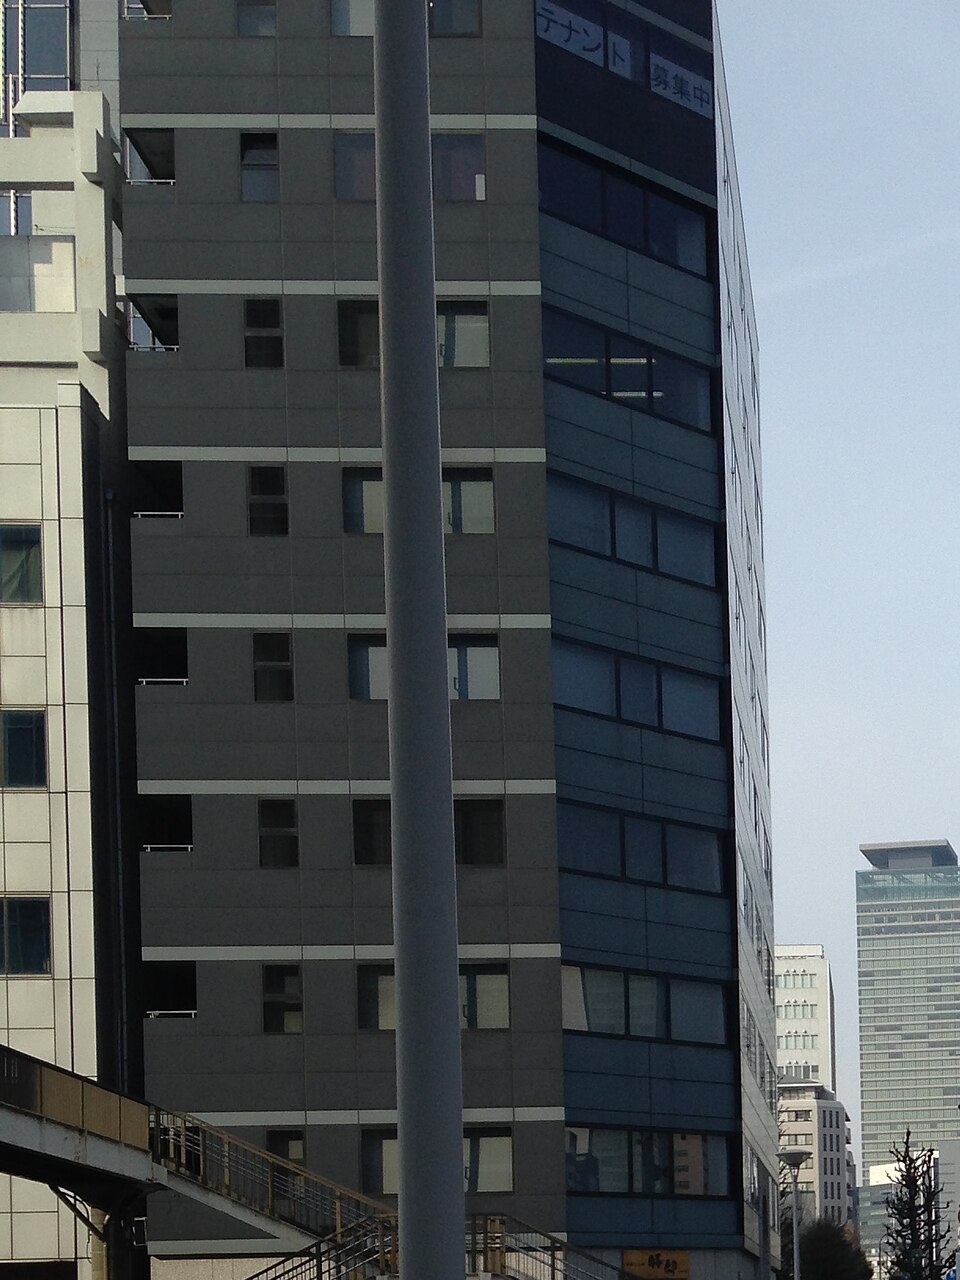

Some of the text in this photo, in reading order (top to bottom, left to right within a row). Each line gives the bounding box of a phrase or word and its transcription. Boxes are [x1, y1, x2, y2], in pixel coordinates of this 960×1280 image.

[537, 7, 710, 108] テナント 募集中
